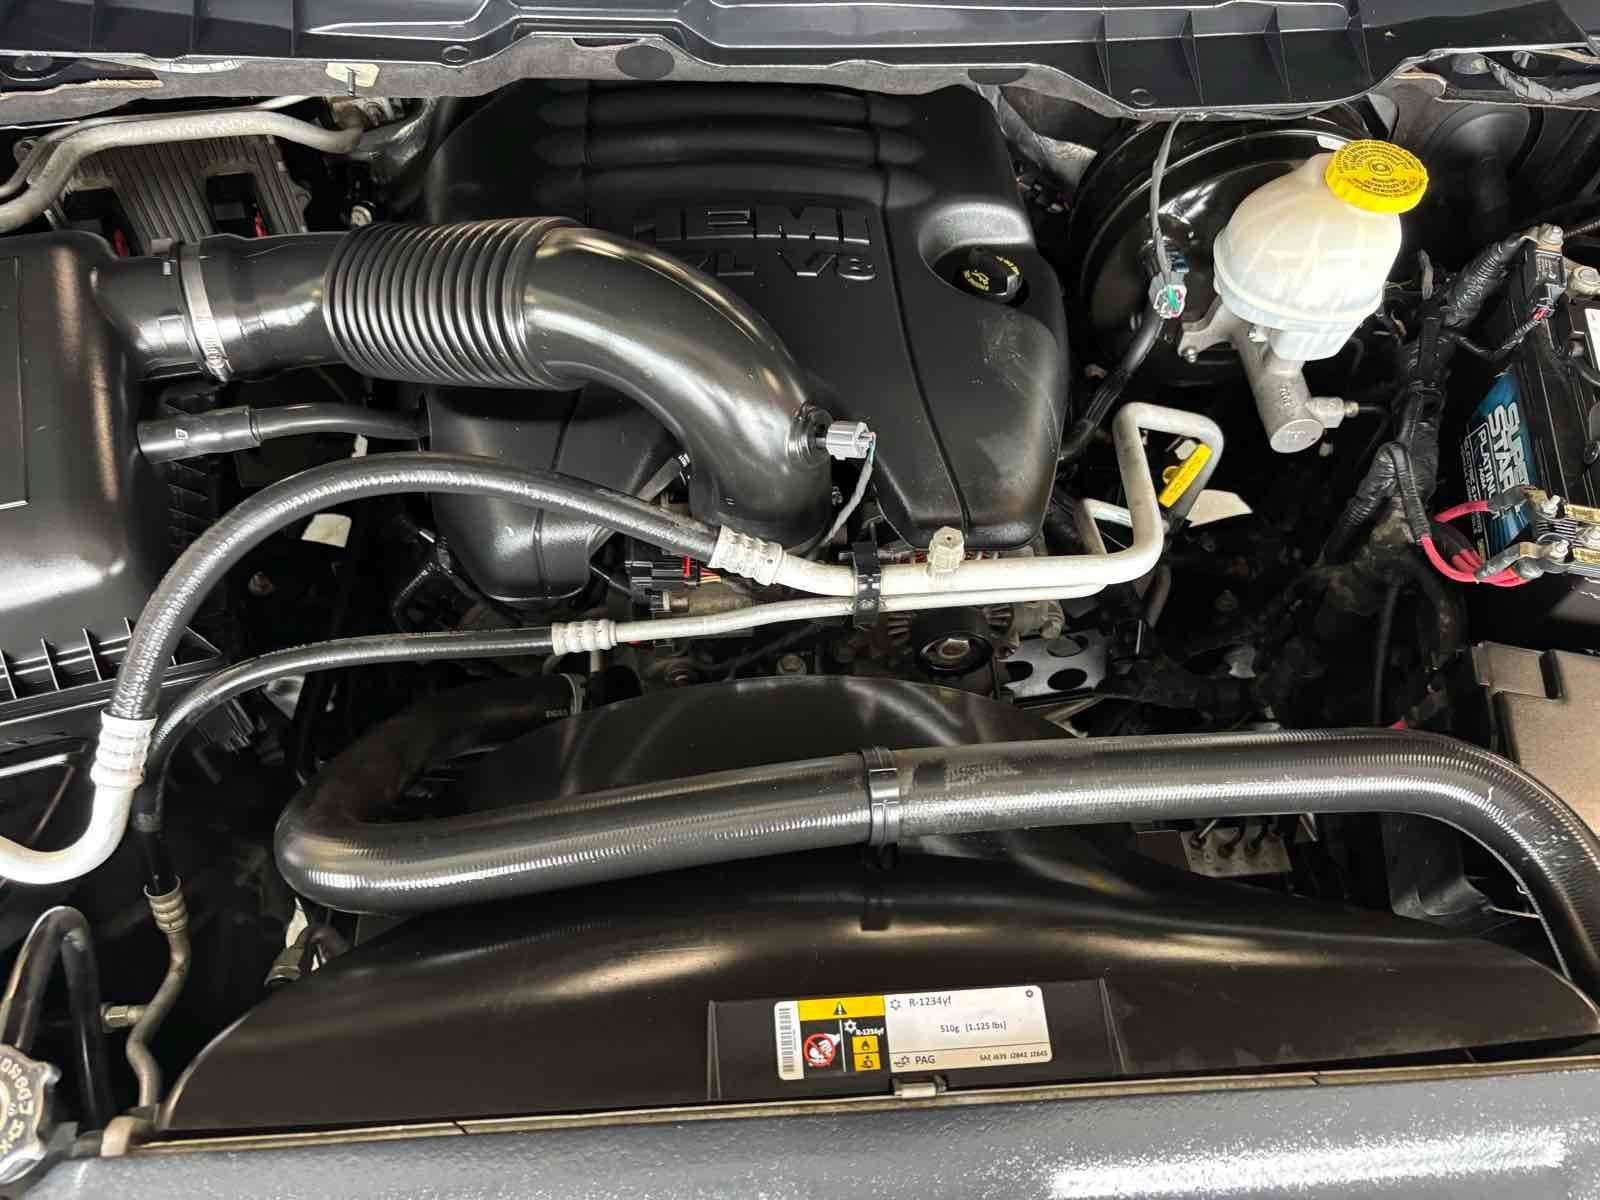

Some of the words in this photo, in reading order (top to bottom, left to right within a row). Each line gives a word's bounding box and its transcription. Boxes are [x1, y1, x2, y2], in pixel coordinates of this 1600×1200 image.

[776, 248, 877, 282] V8
[1505, 401, 1530, 487] SUPE
[1488, 404, 1518, 511] STAR
[909, 995, 951, 1008] R-1234yf
[940, 1025, 960, 1034] 510g
[915, 1055, 936, 1065] PAG
